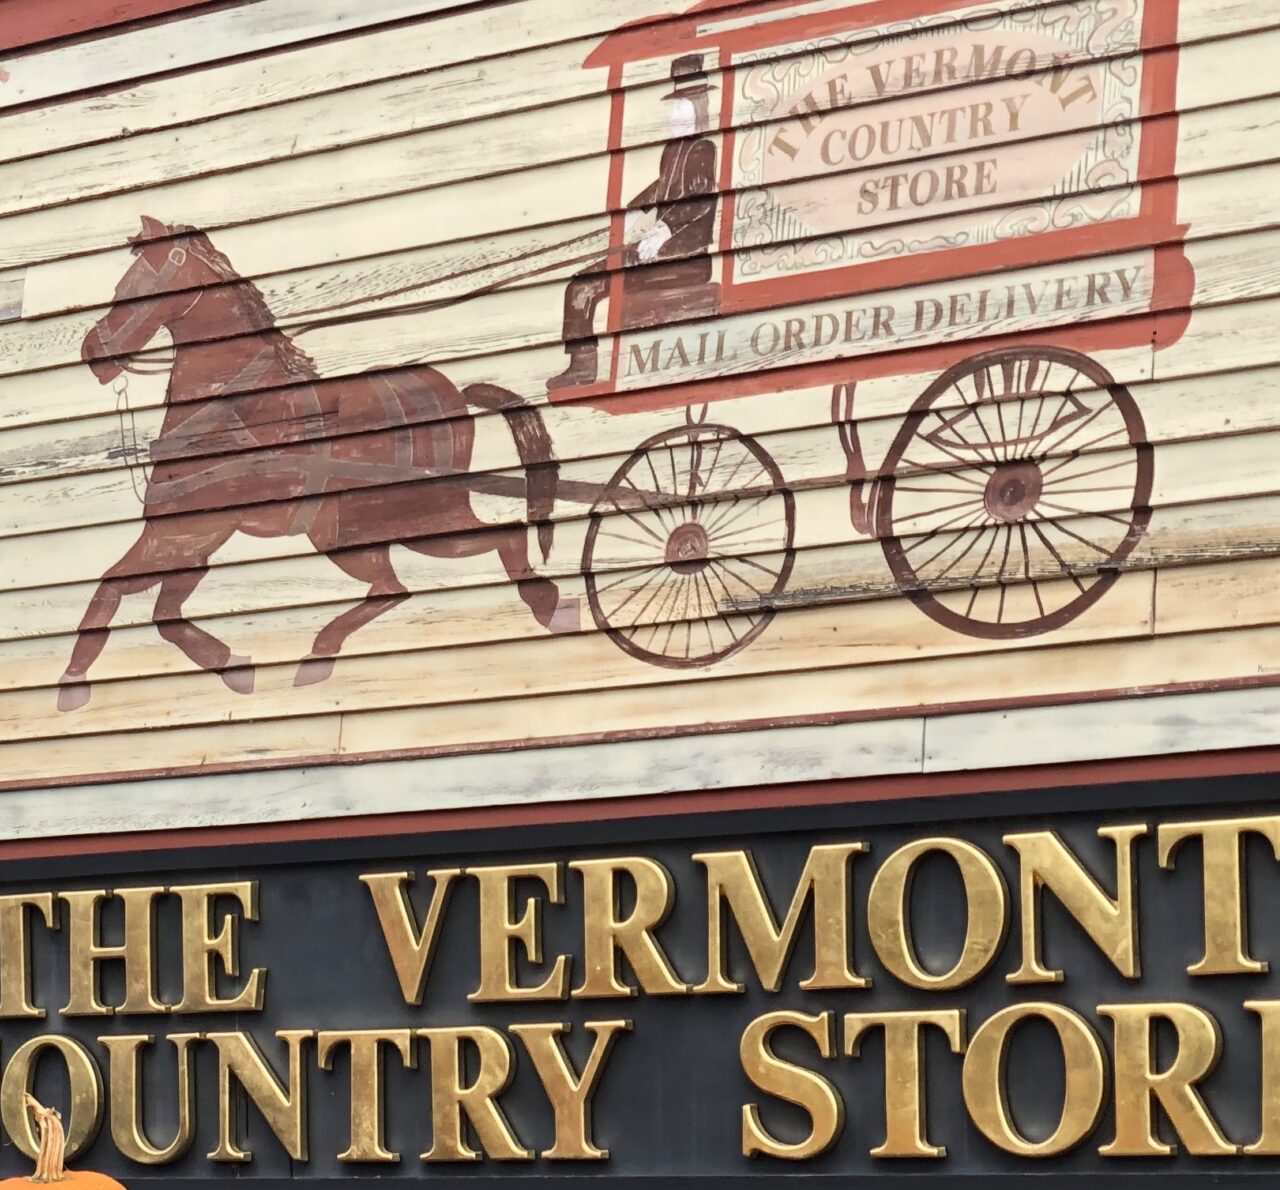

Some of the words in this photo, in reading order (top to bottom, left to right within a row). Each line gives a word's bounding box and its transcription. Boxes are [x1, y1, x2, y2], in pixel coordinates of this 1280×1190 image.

[768, 73, 853, 161] THE
[866, 43, 1098, 112] VERMONT
[821, 93, 1032, 165] COUNTRY
[857, 158, 998, 215] STORE
[626, 330, 740, 376] MAIL
[750, 303, 896, 357] ORDER
[913, 265, 1144, 334] DELIVERY
[359, 816, 1280, 1005] VERMONT
